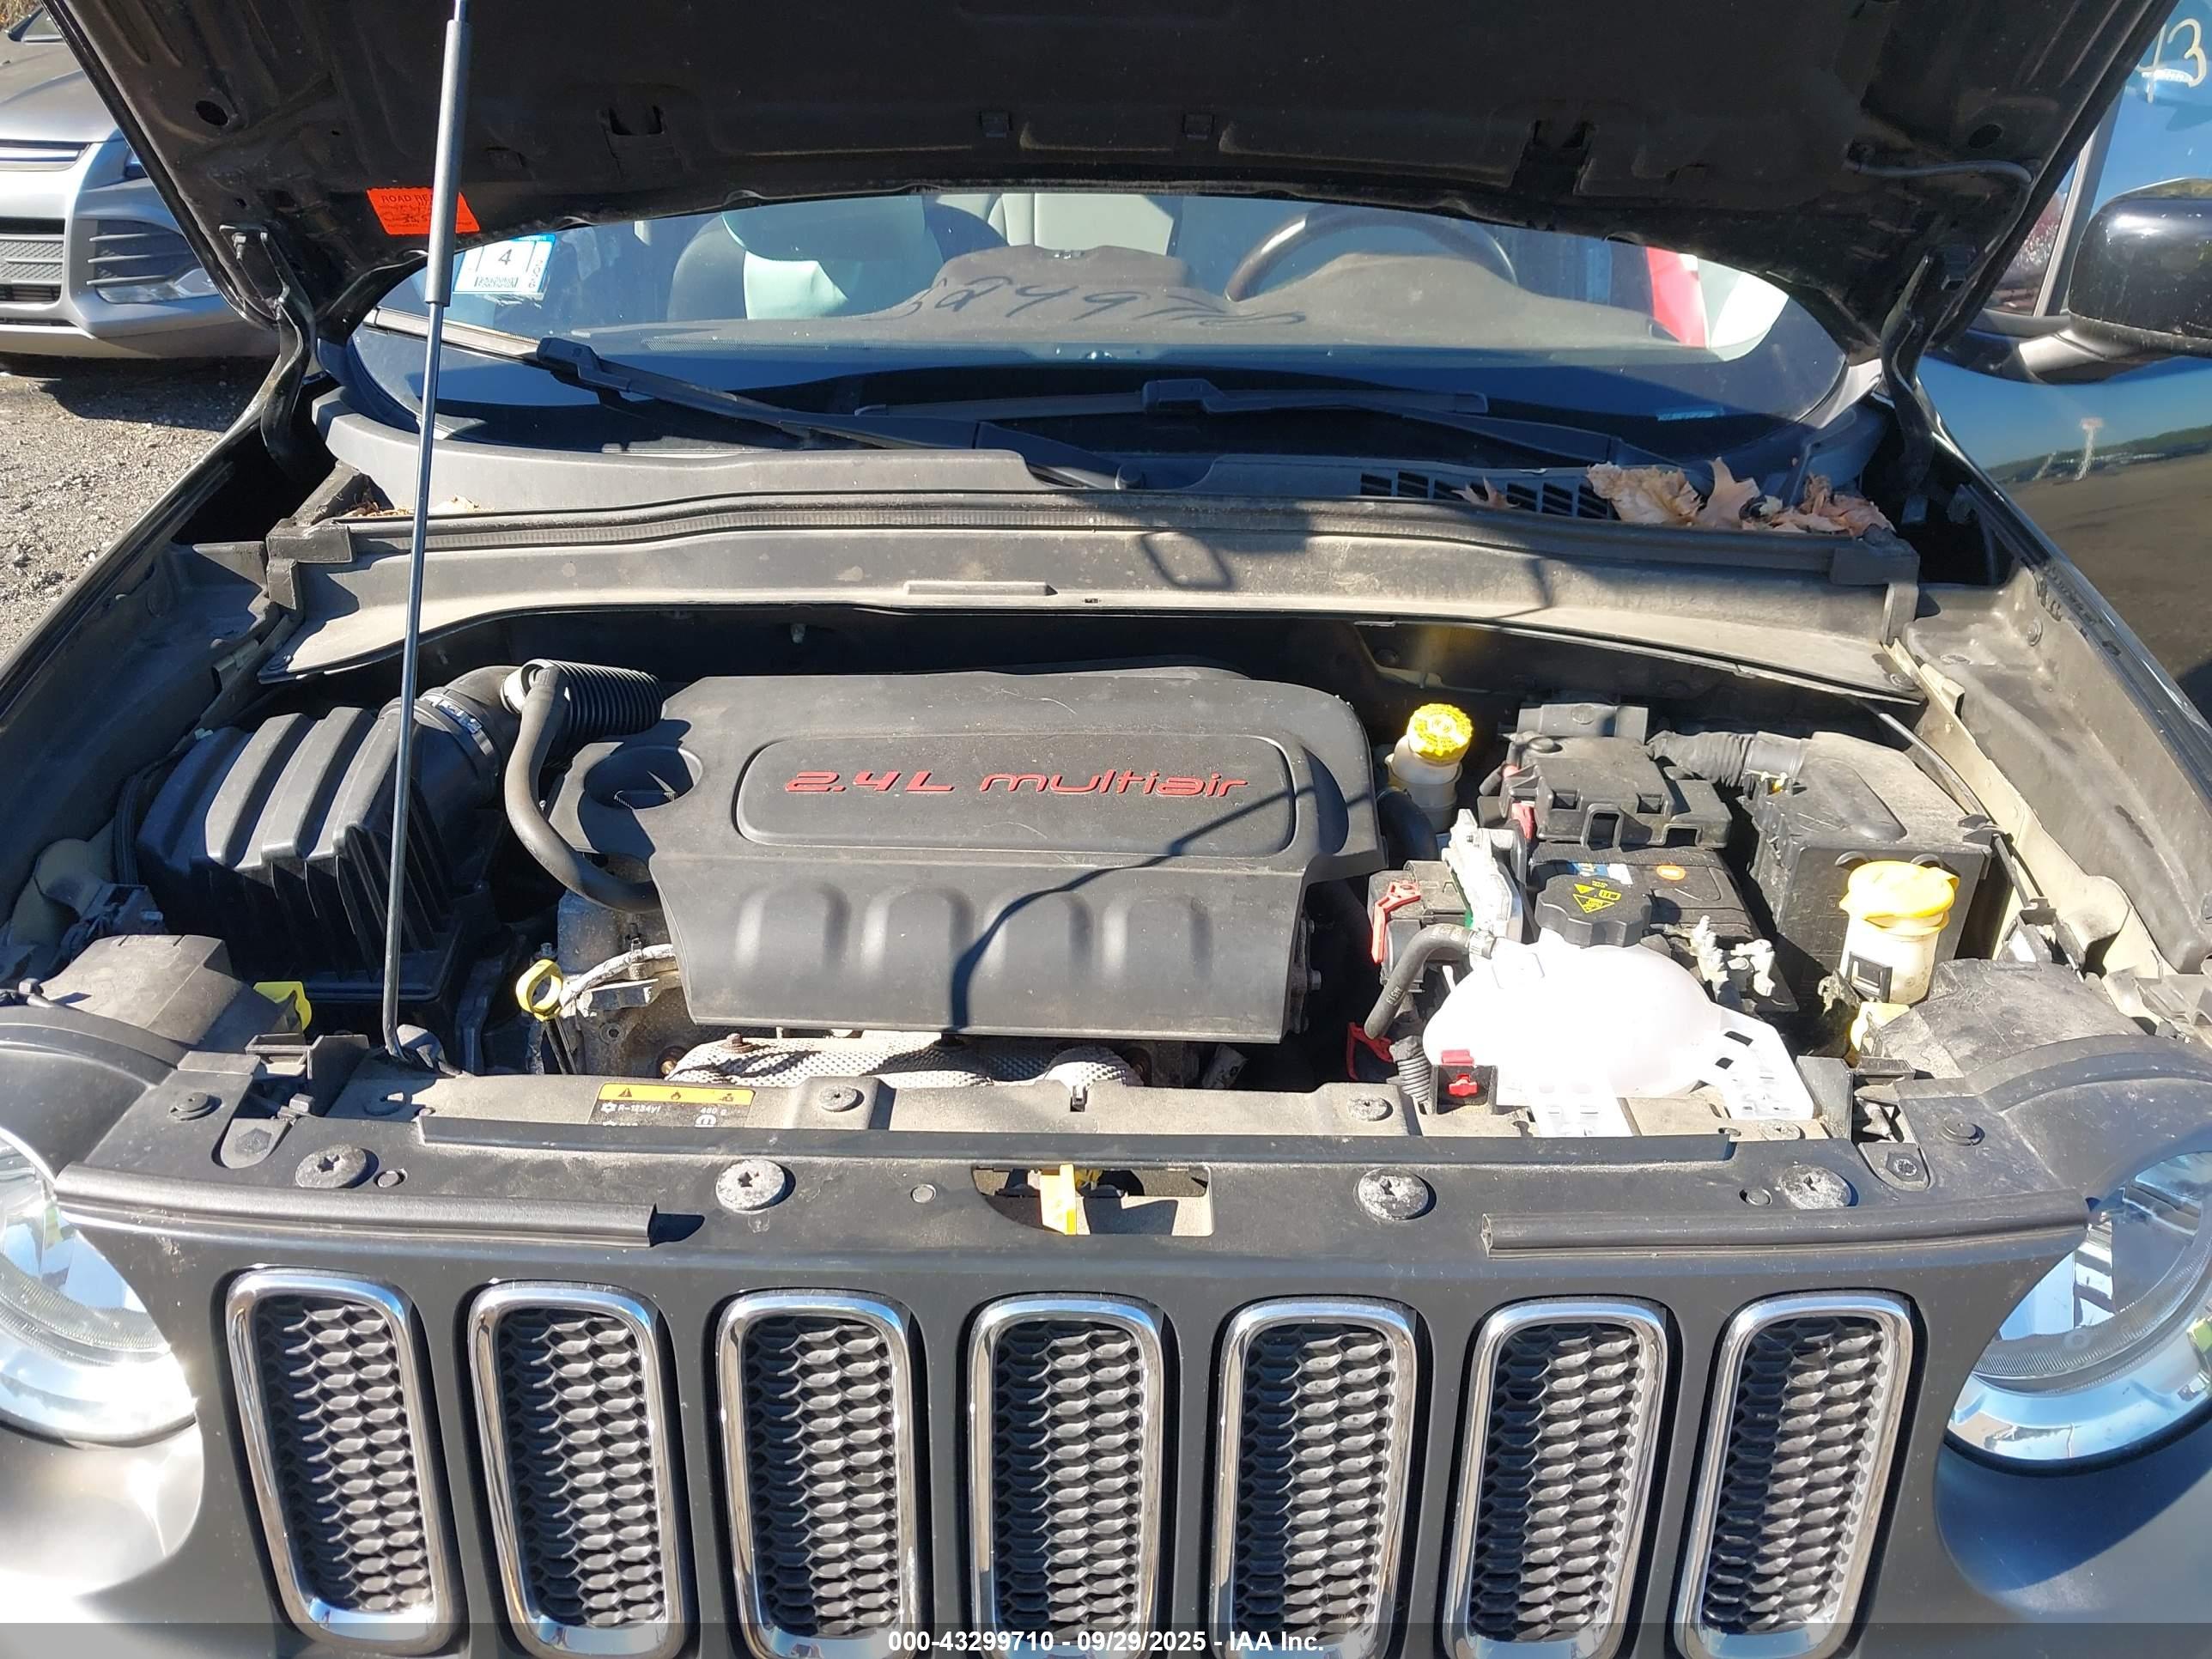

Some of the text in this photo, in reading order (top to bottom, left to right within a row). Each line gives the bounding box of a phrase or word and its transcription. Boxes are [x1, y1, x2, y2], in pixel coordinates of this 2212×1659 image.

[380, 194, 412, 204] ROAD
[498, 248, 513, 265] 4
[979, 769, 1249, 798] multiair
